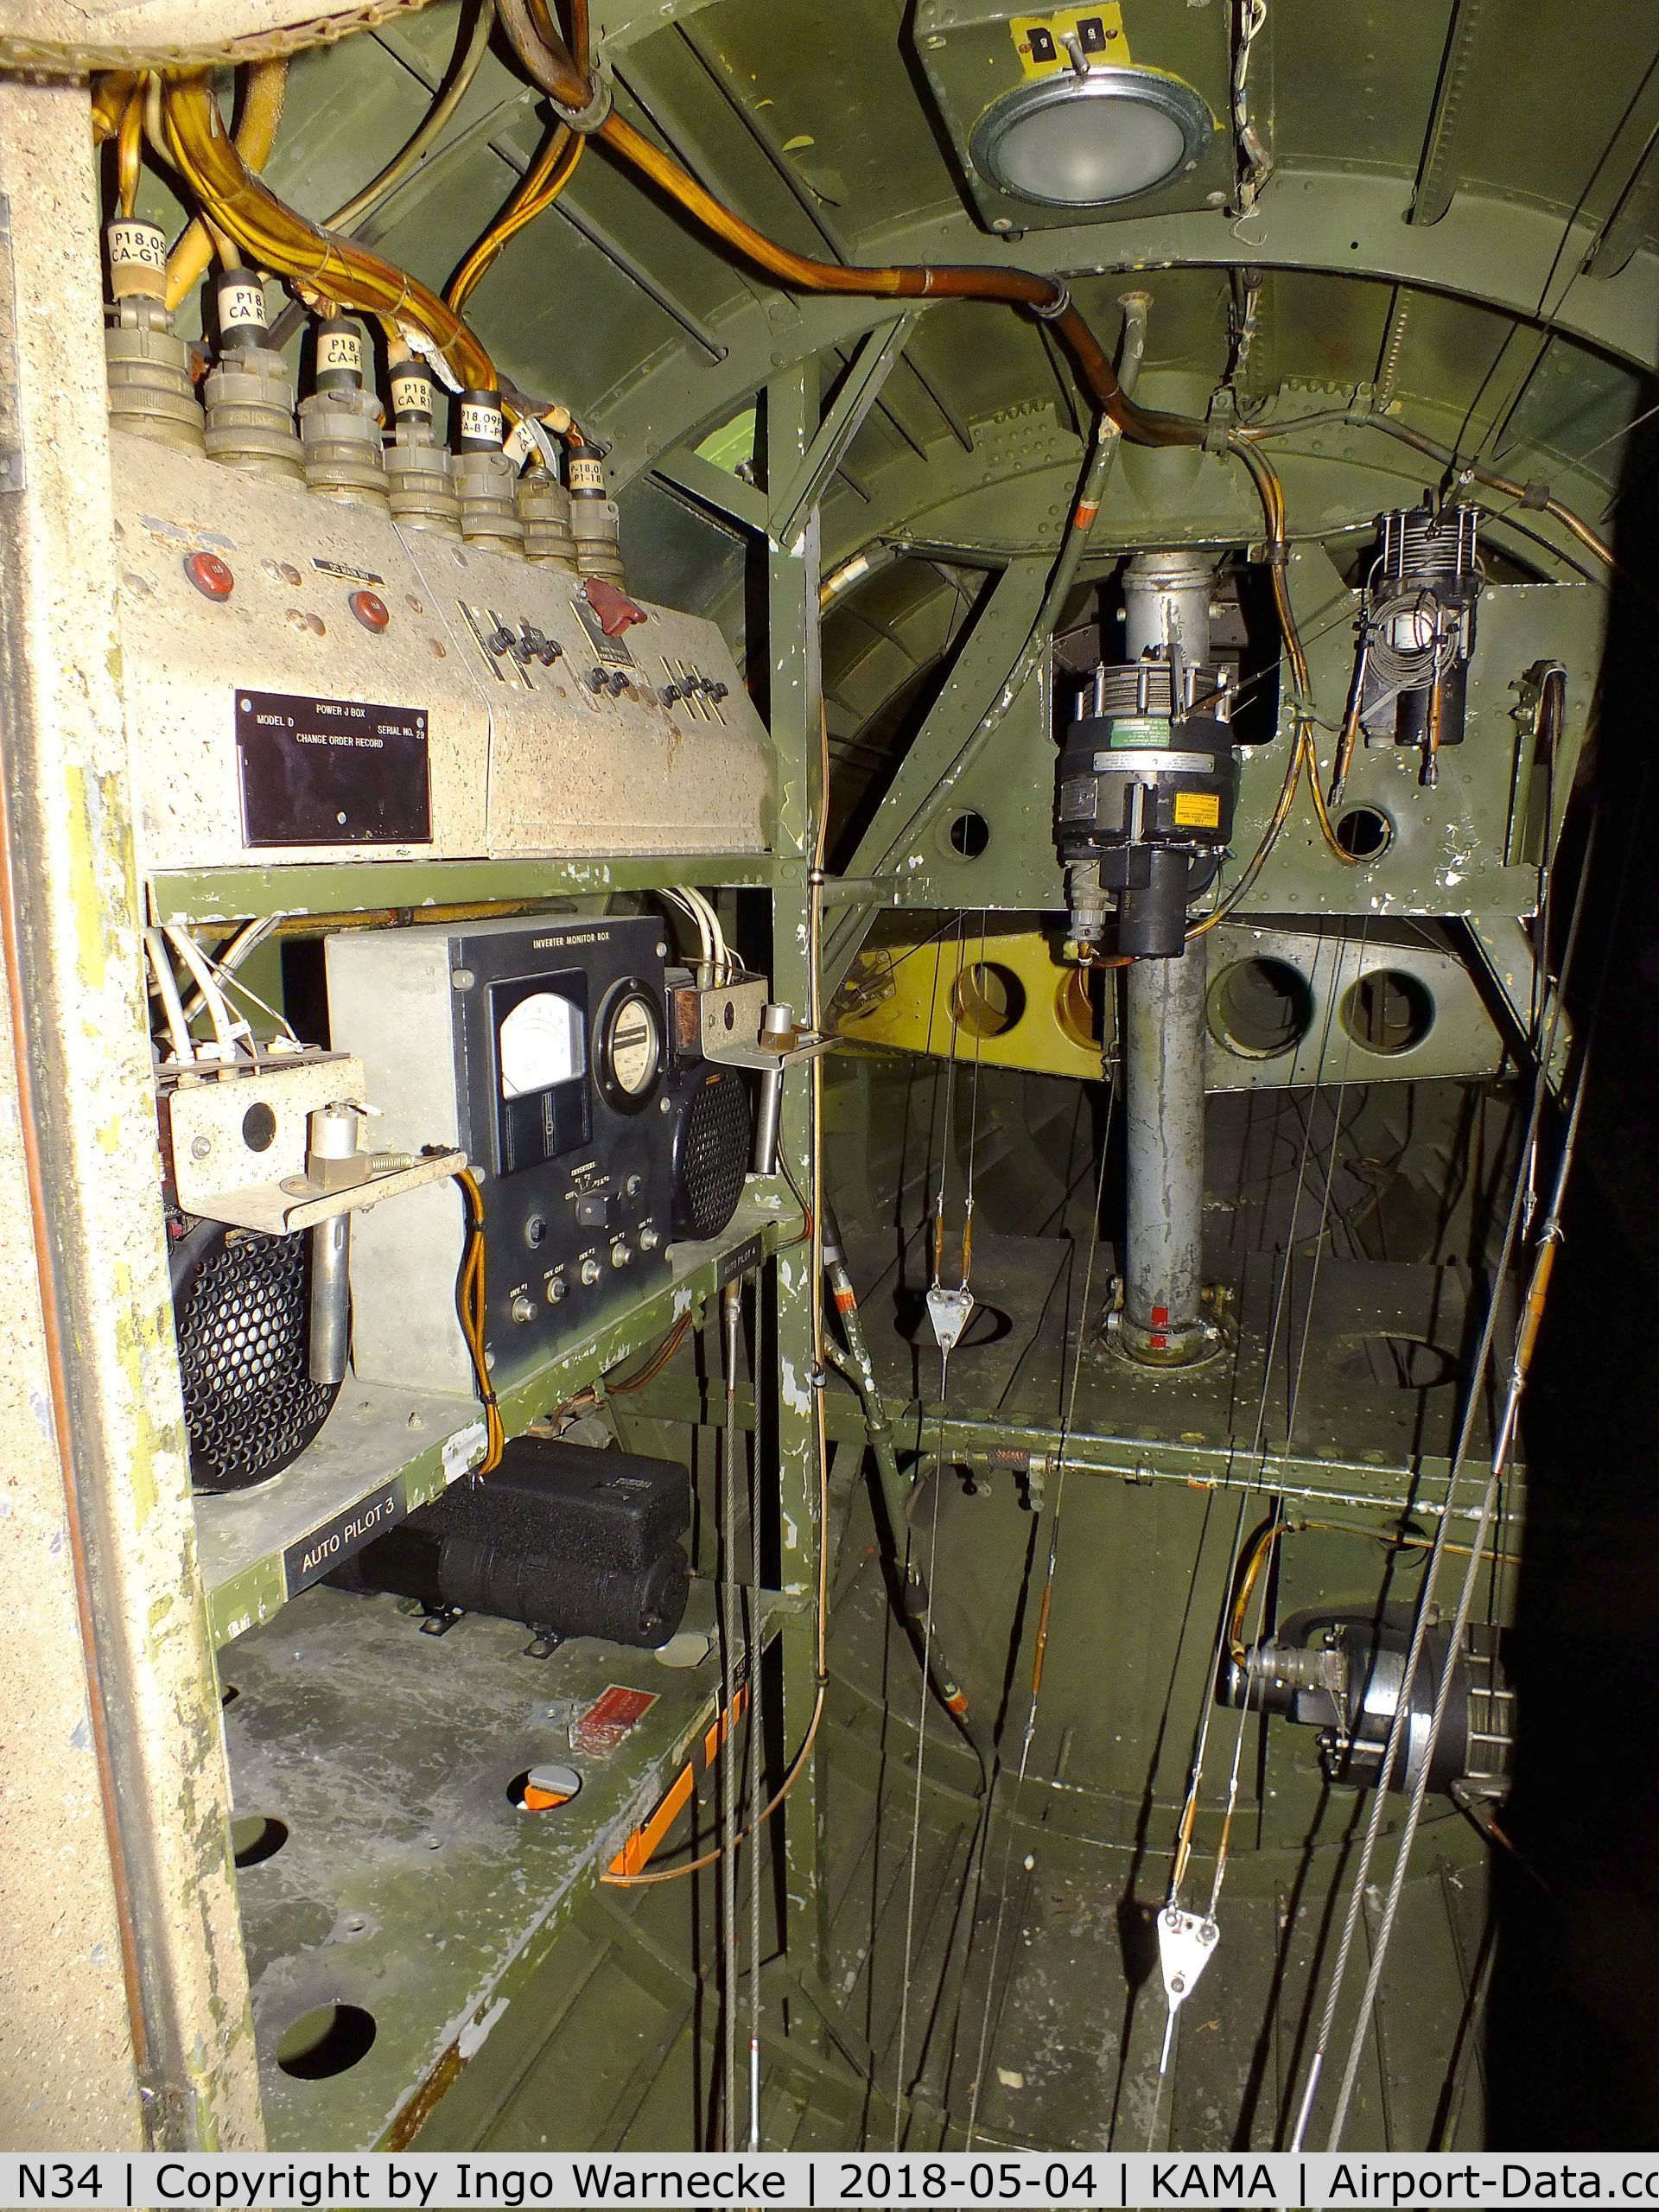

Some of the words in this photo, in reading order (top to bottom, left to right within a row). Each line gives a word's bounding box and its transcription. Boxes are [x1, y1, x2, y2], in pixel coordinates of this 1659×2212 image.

[1087, 28, 1097, 41] OFF
[1039, 38, 1049, 48] ON
[229, 306, 250, 319] CA
[397, 396, 415, 406] CA
[316, 703, 343, 717] POWER
[344, 707, 350, 717] J
[351, 708, 366, 719] BOX
[257, 714, 286, 727] MODEL
[288, 716, 295, 728] D
[377, 724, 402, 736] SERIAL
[416, 730, 426, 740] 29
[296, 733, 327, 745] CHANGE
[328, 735, 354, 747] ORDER
[355, 738, 385, 749] RECORD
[532, 937, 564, 950] INVERTER
[566, 932, 595, 945] MONITOR
[596, 931, 610, 942] BOX
[554, 1263, 564, 1274] OFF
[725, 1259, 737, 1275] AUTO
[737, 1249, 752, 1267] PILOT
[302, 1533, 340, 1573] AUTO
[343, 1503, 383, 1543] PILOT
[385, 1496, 395, 1515] 3
